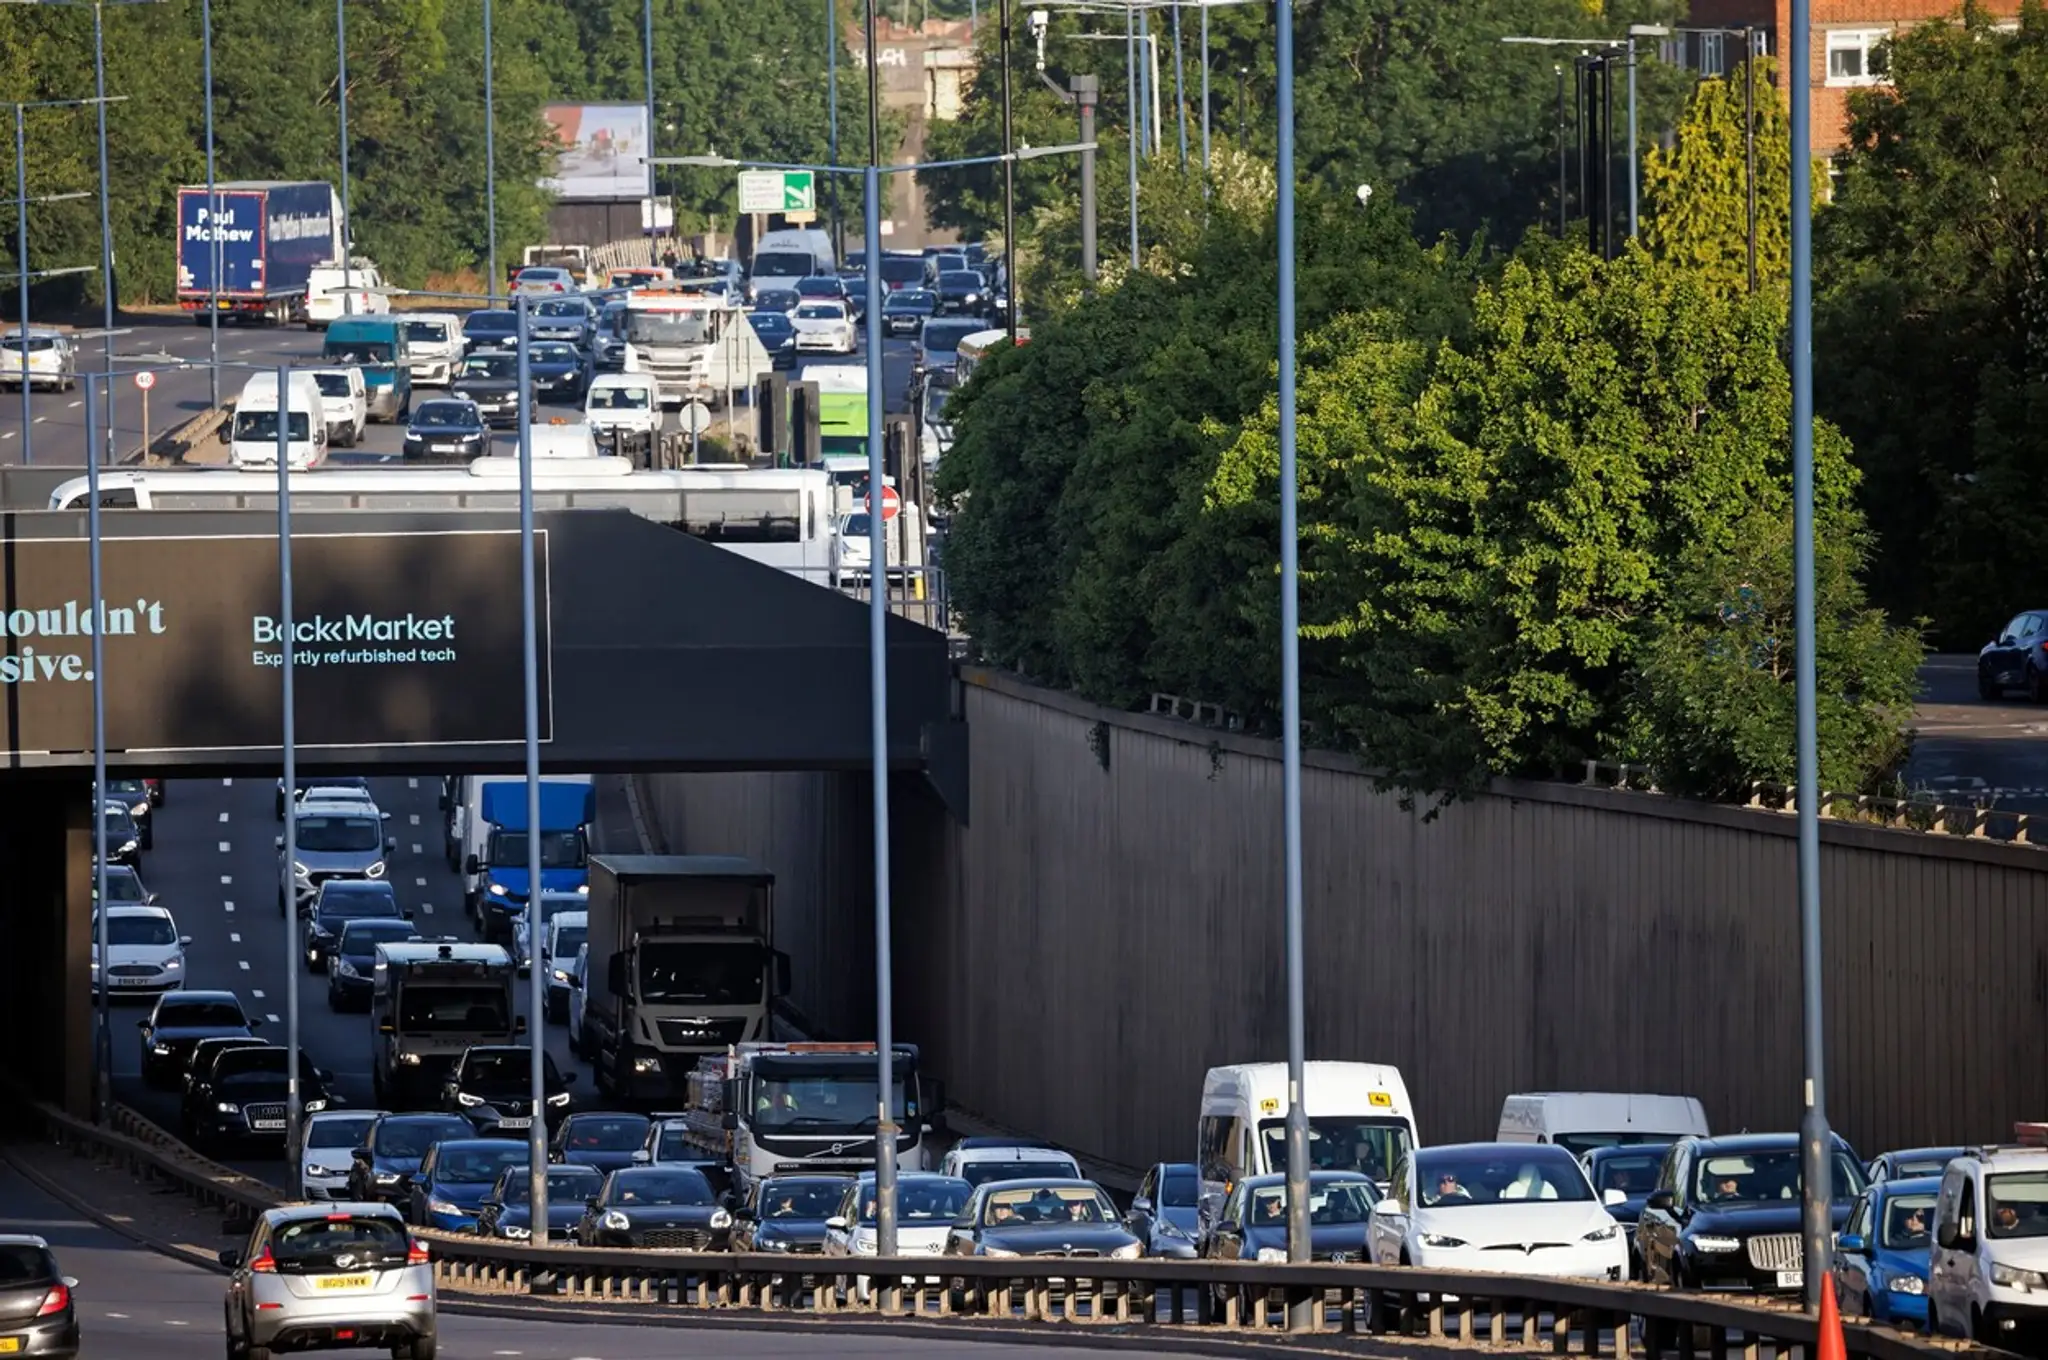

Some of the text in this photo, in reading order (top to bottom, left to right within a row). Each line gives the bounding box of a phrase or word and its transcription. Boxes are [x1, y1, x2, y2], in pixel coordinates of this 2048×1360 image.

[0, 598, 167, 637] ouldn't
[346, 613, 455, 640] Market
[0, 646, 94, 682] sive.
[253, 648, 456, 667] Exprtly refurbished tech
